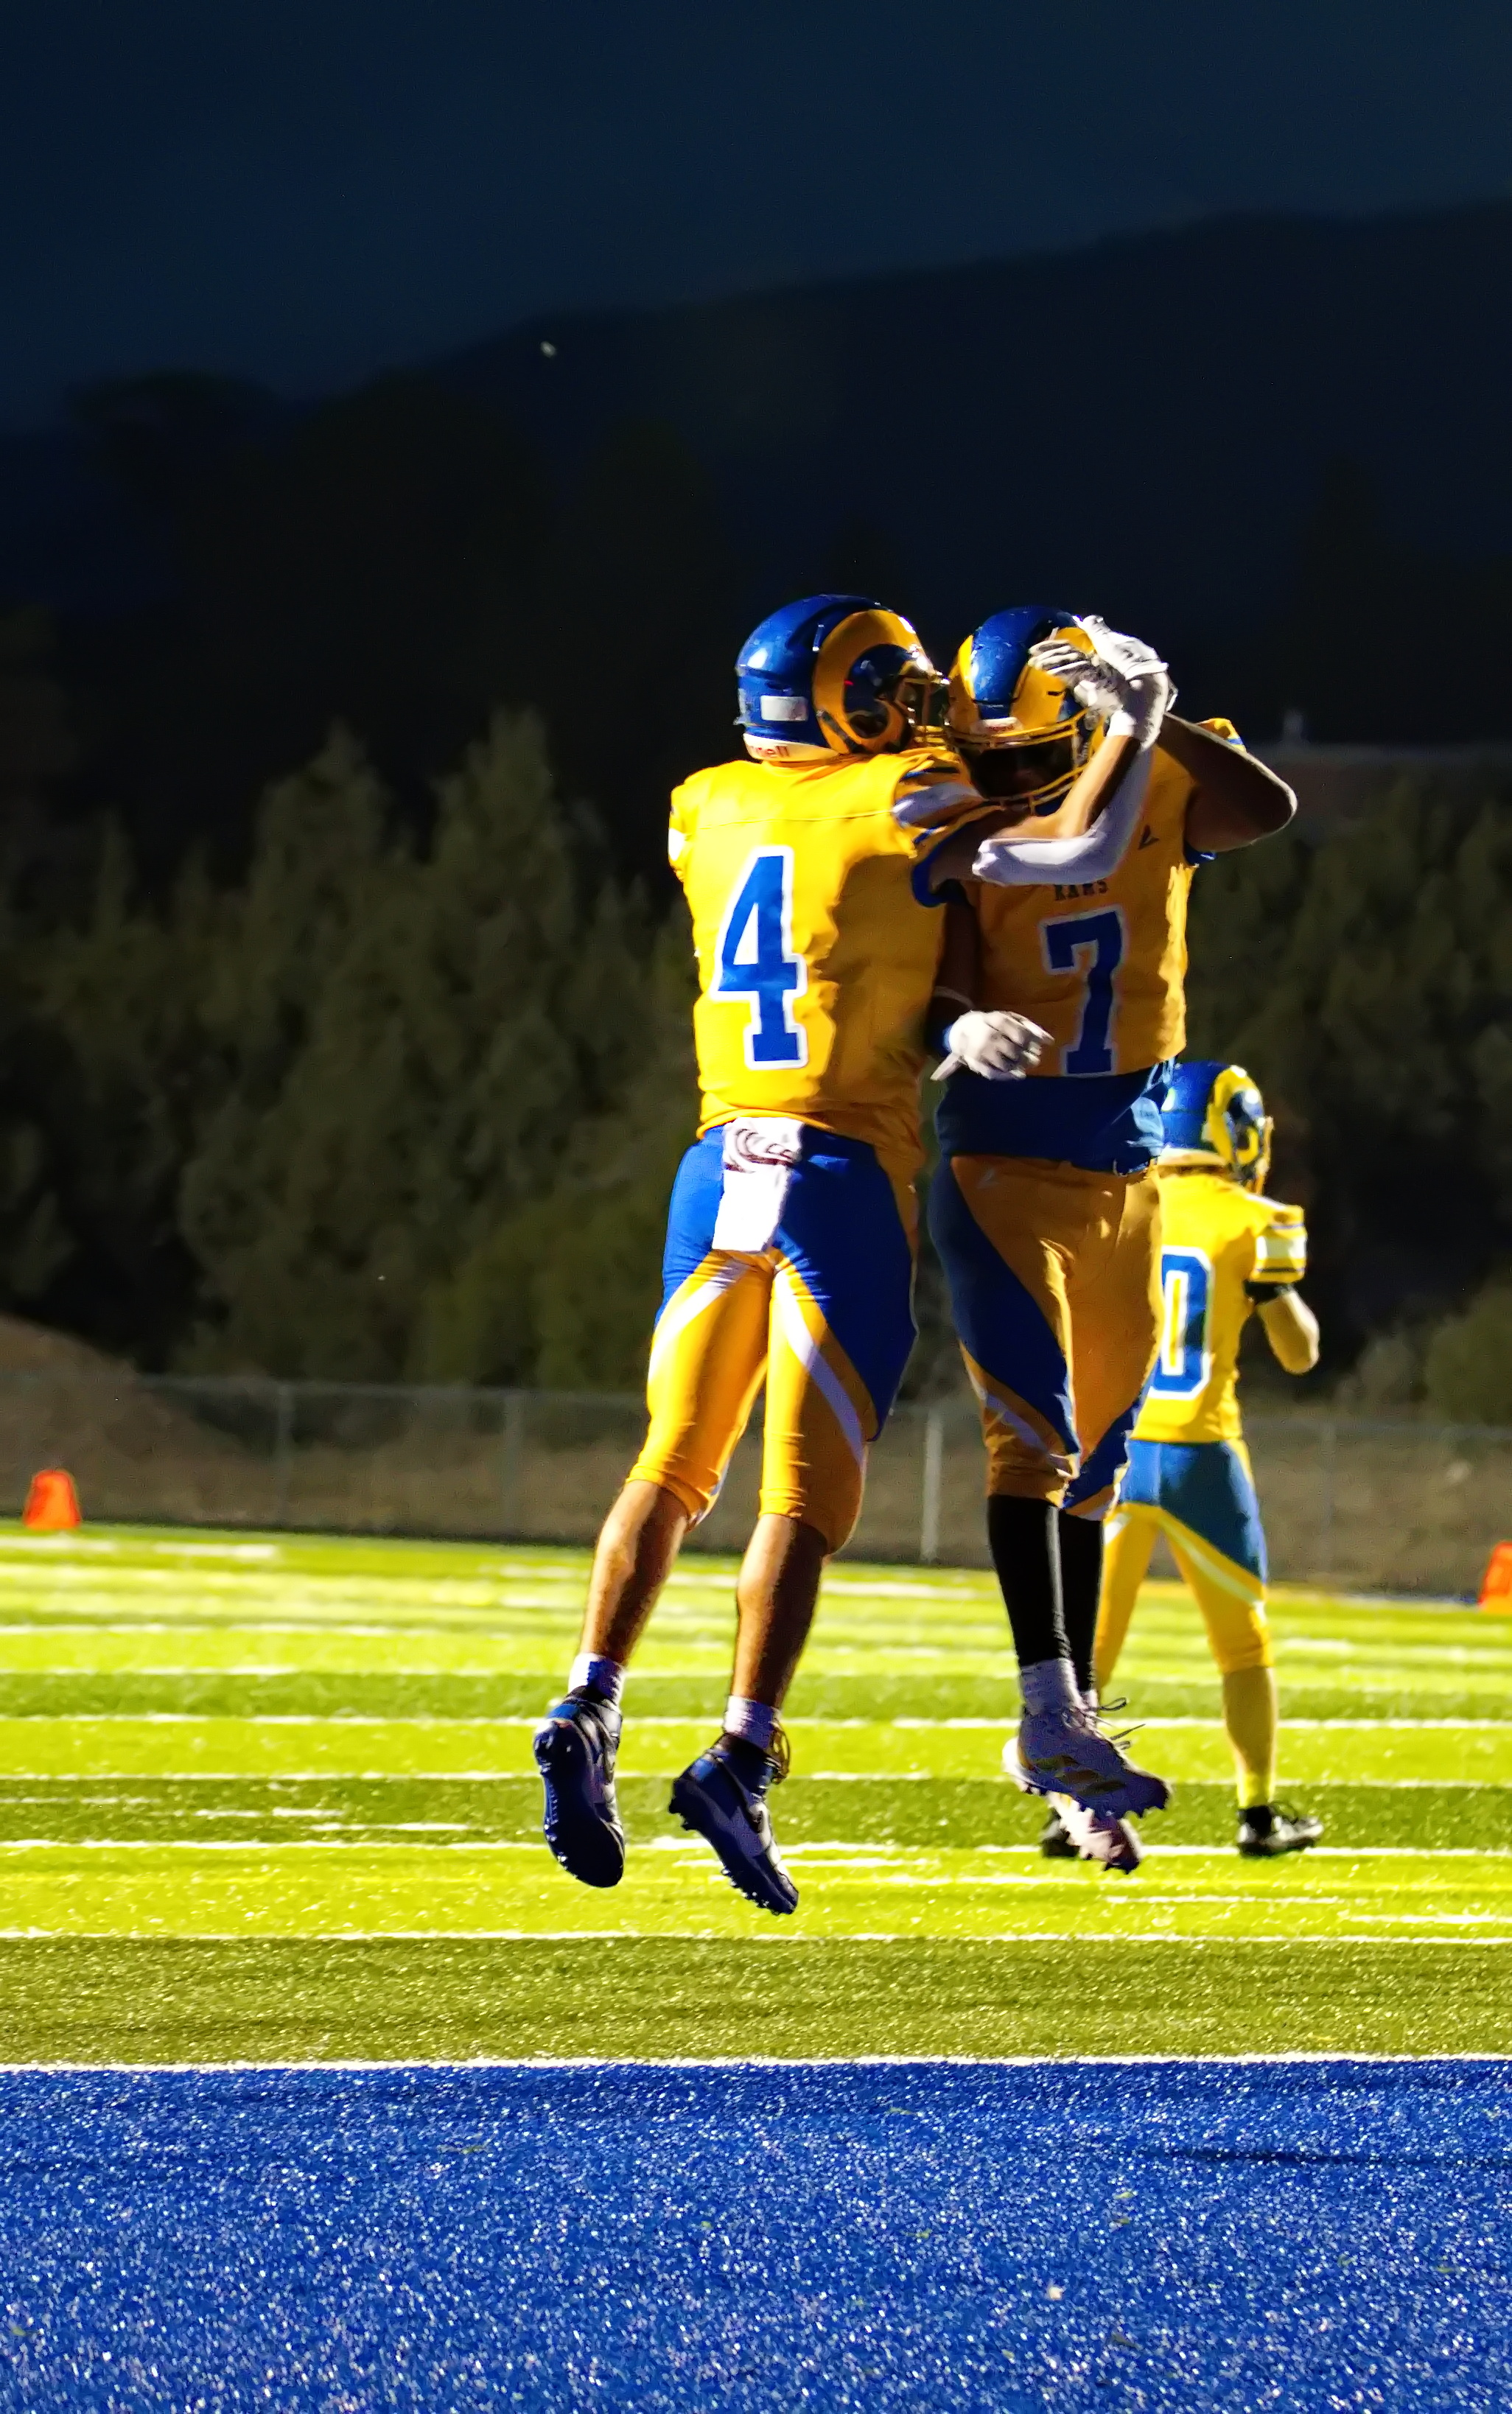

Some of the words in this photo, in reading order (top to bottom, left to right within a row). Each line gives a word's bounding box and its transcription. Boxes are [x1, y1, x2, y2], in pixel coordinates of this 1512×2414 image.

[710, 846, 808, 1069] 4
[1039, 904, 1127, 1077] 7
[1150, 1245, 1213, 1399] 0
